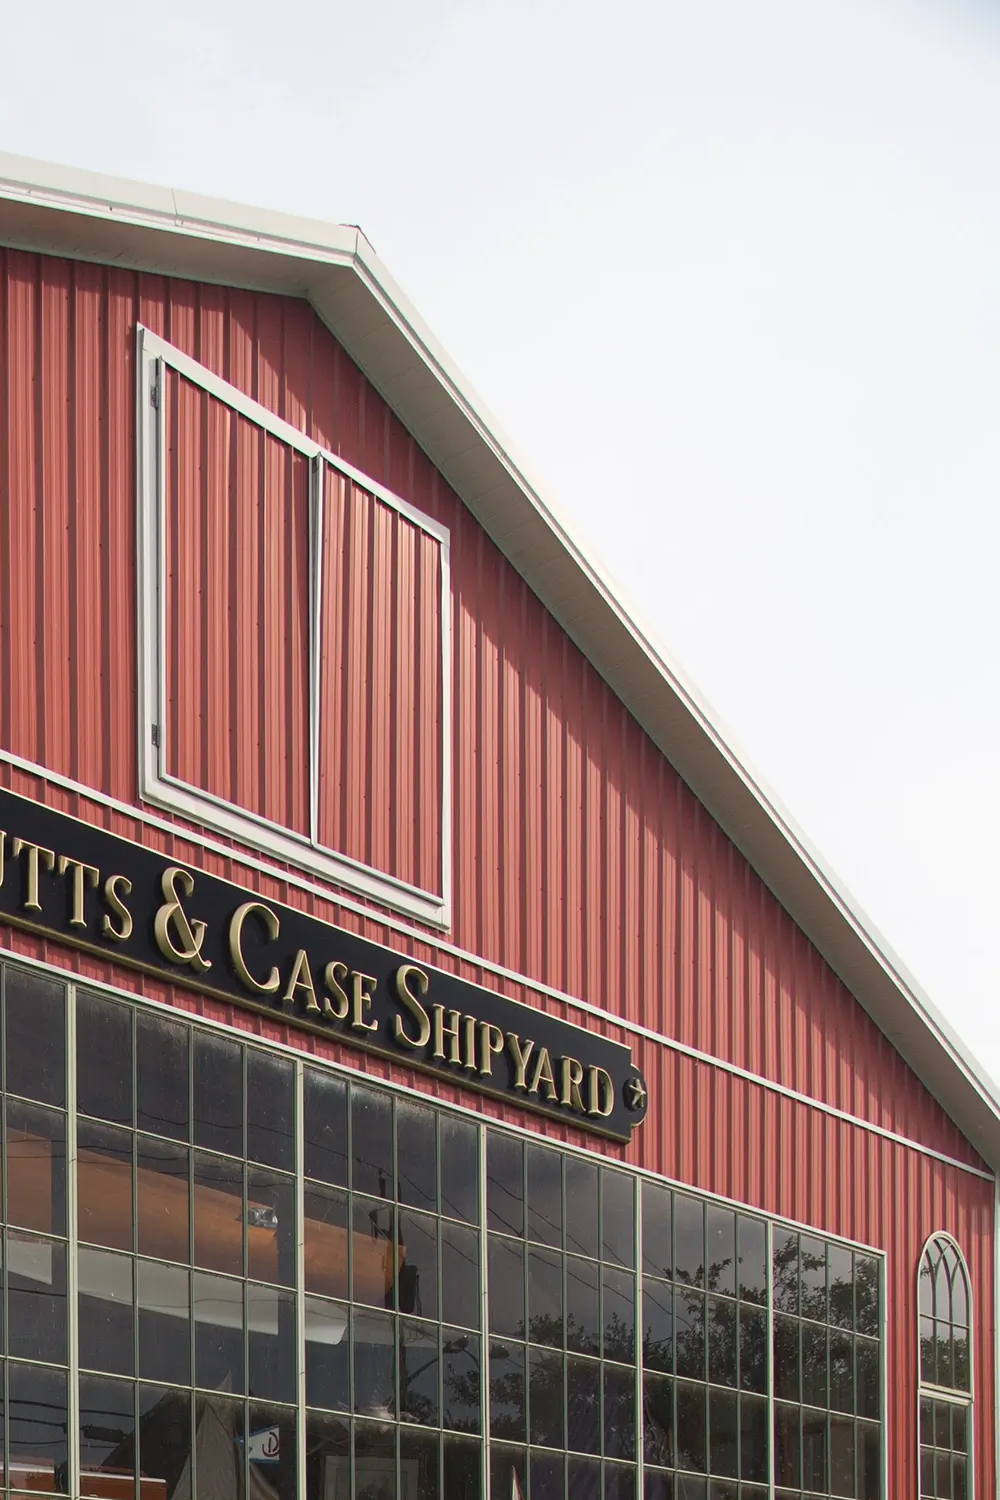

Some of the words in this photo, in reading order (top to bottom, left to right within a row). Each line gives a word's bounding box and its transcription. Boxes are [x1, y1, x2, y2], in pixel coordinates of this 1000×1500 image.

[154, 867, 212, 972] &
[229, 902, 379, 1031] CASE
[396, 964, 615, 1117] SHIPYARD
